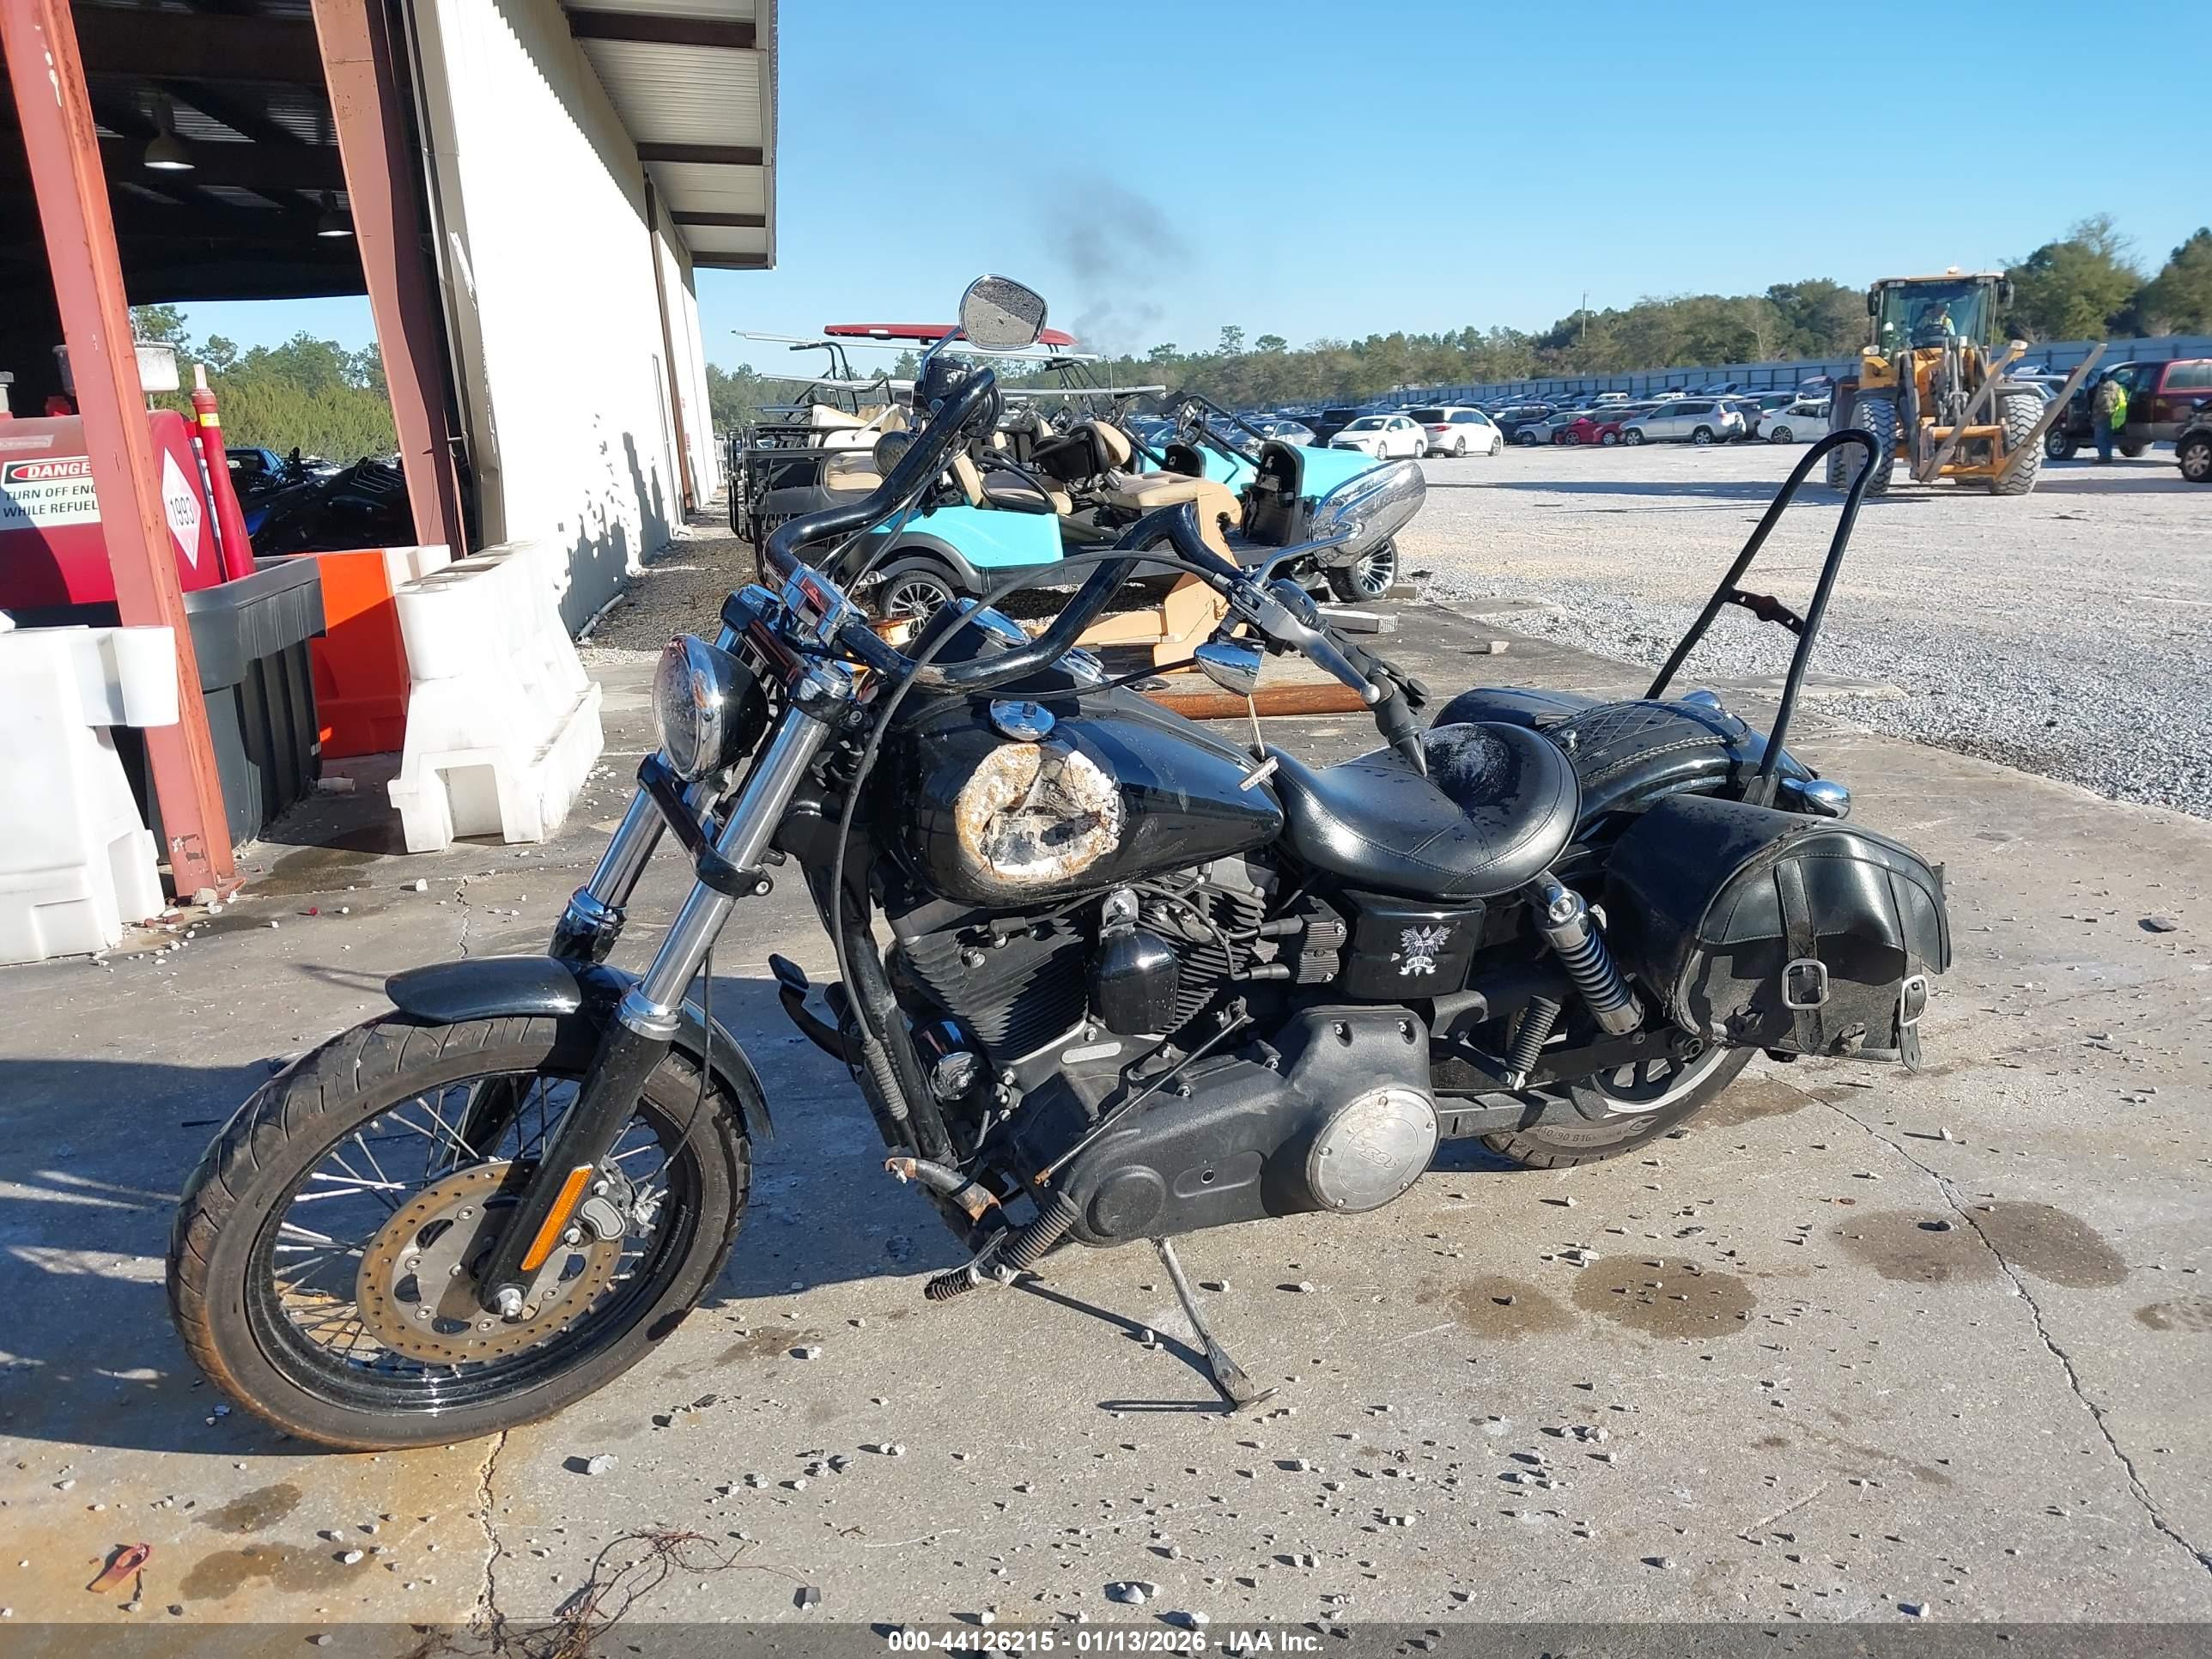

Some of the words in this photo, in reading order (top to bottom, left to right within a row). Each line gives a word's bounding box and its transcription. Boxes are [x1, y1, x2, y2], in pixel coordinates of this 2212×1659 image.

[27, 462, 91, 478] DANGE
[6, 489, 41, 501] TURN
[46, 486, 69, 498] OFF
[3, 504, 46, 518] WHILE
[51, 500, 99, 514] REFUEL
[170, 496, 195, 526] 1993
